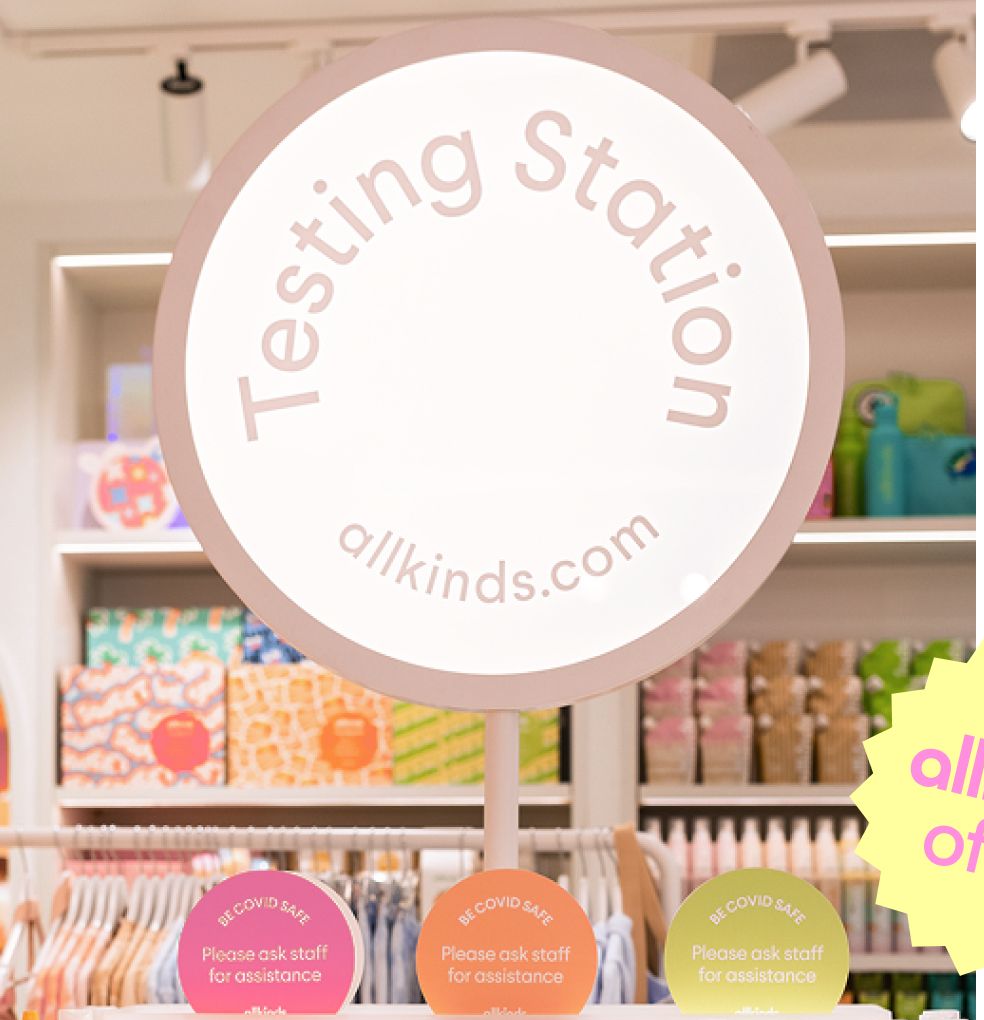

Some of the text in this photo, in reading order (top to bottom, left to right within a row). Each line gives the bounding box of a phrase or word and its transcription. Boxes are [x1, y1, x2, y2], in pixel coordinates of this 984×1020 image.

[237, 109, 744, 444] Testing Station
[338, 511, 660, 604] allkinds.com
[218, 896, 312, 927] BE COVID SAFE
[458, 896, 554, 927] BE COVID SAFE
[709, 894, 807, 926] BE COVID SAFE
[202, 944, 329, 962] Please ask staff
[441, 946, 571, 962] Please ask staff
[692, 944, 825, 961] Please ask staff
[208, 967, 322, 984] for assistance
[448, 967, 564, 984] for assistance
[698, 967, 817, 984] for assistance
